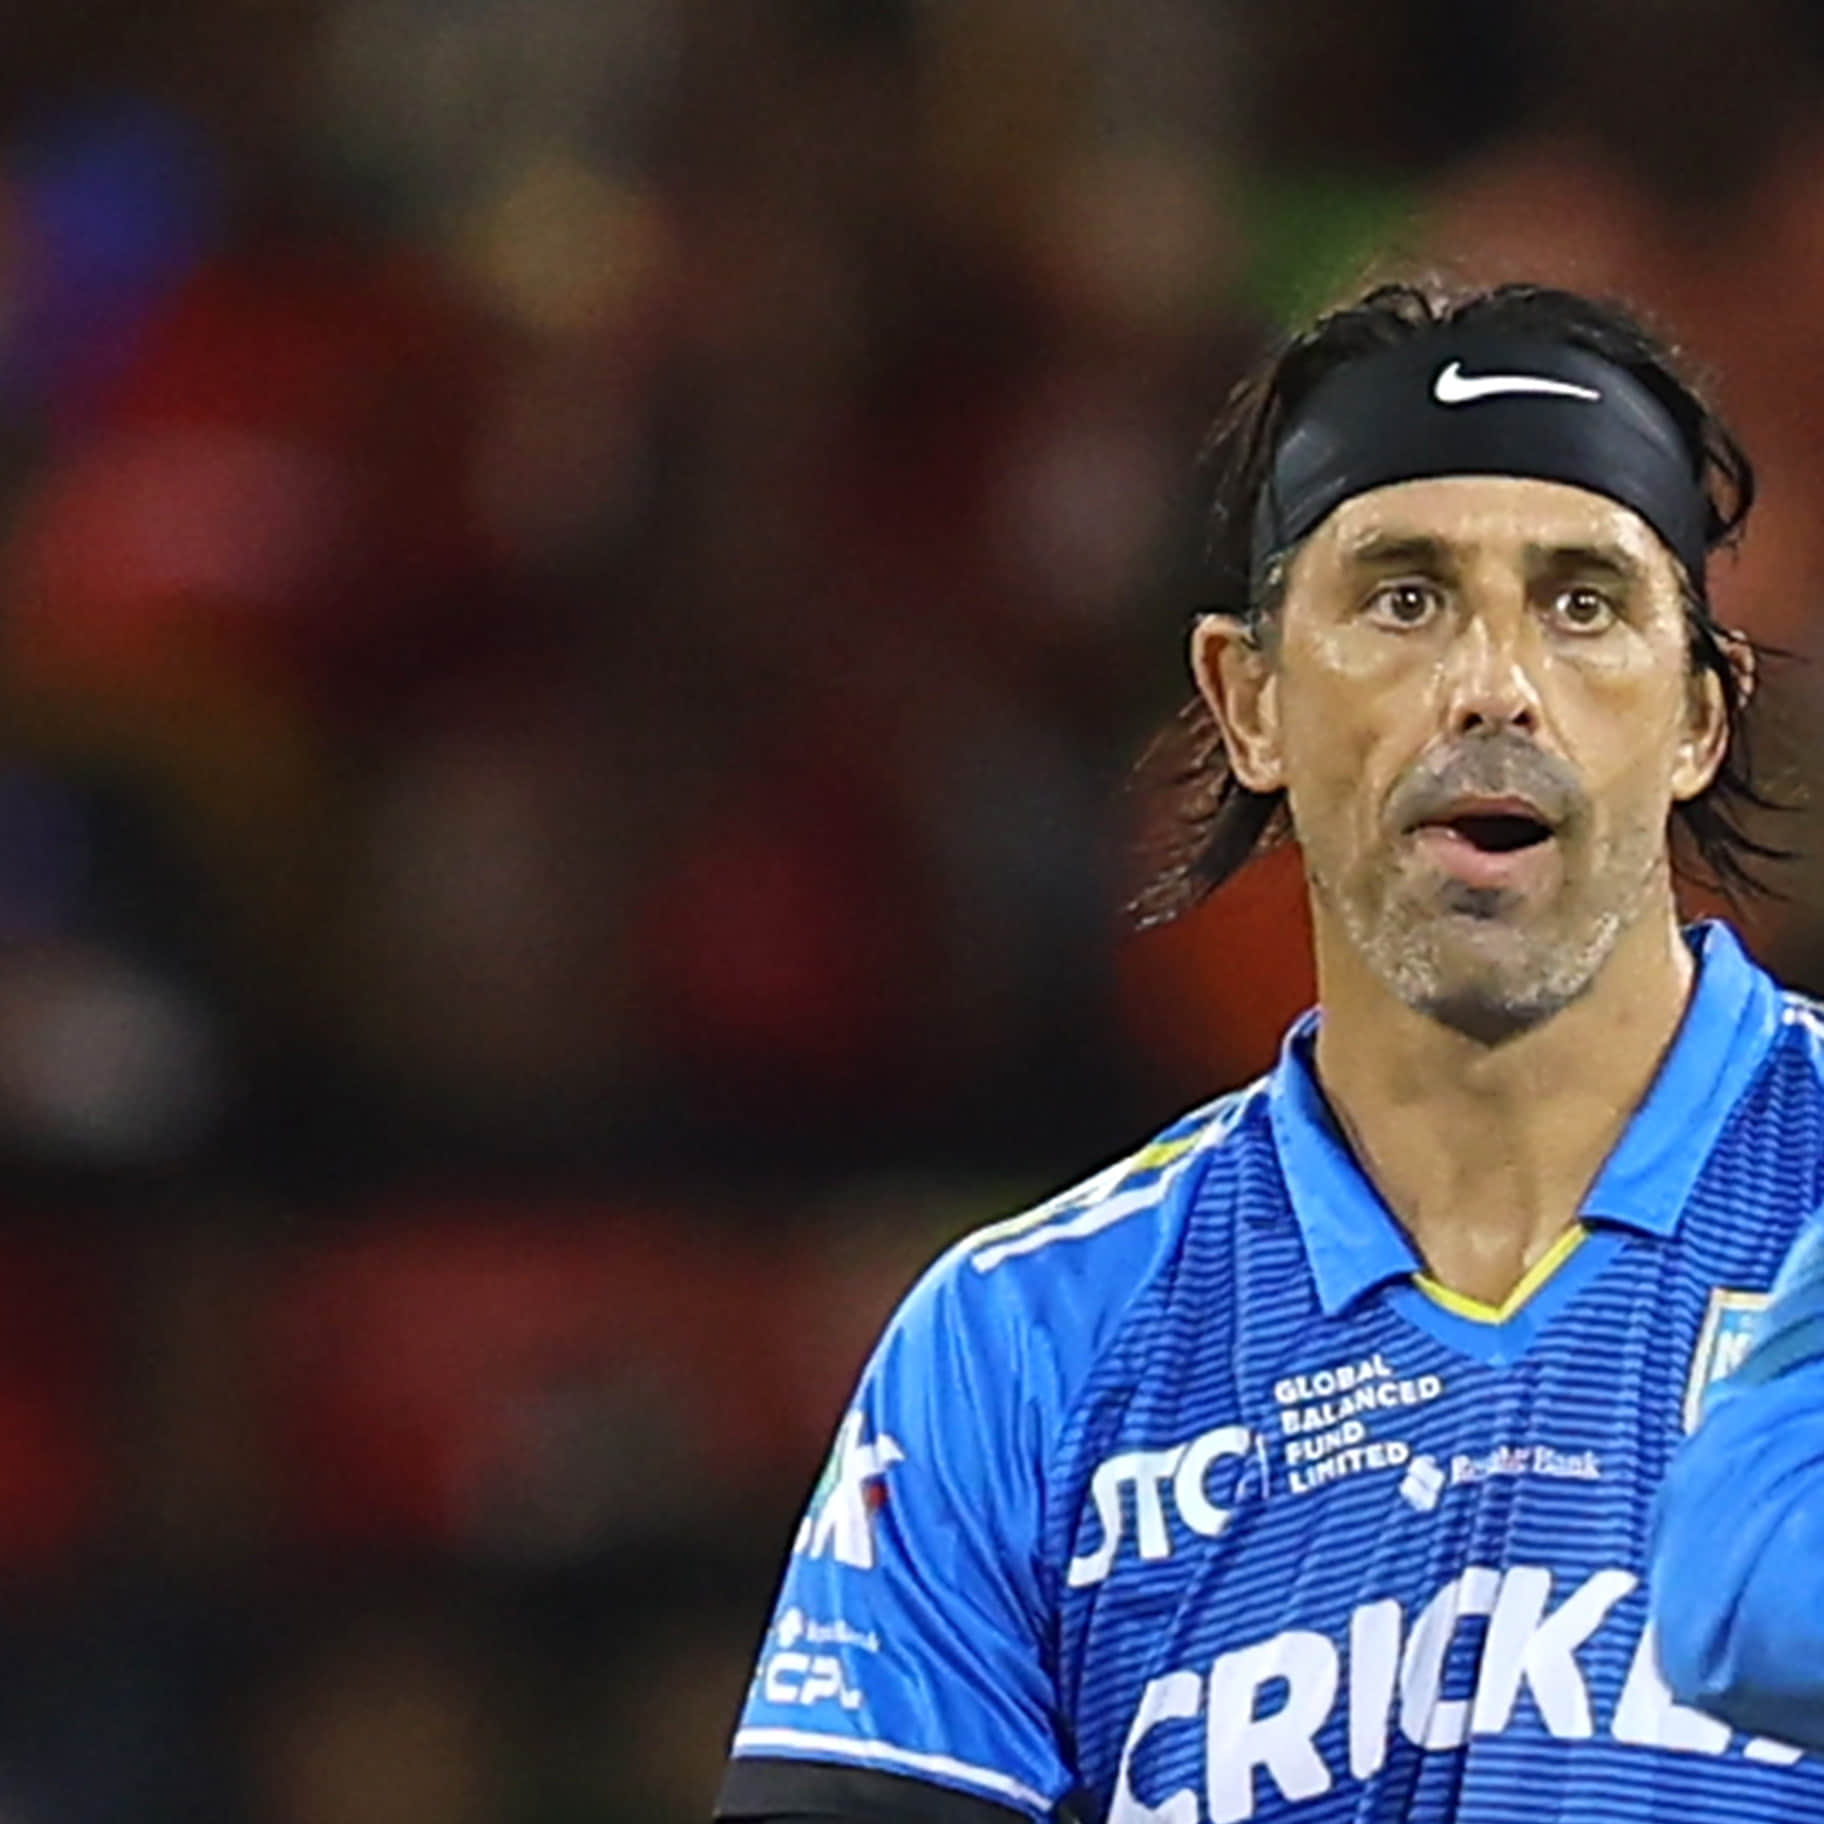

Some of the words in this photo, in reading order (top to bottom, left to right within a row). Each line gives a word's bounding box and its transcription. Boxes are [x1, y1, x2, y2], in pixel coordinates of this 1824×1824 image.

[1275, 1353, 1392, 1404] GLOBAL
[1281, 1375, 1441, 1434] BALANCED
[1285, 1421, 1365, 1466] FUND
[1289, 1441, 1408, 1494] LIMITED
